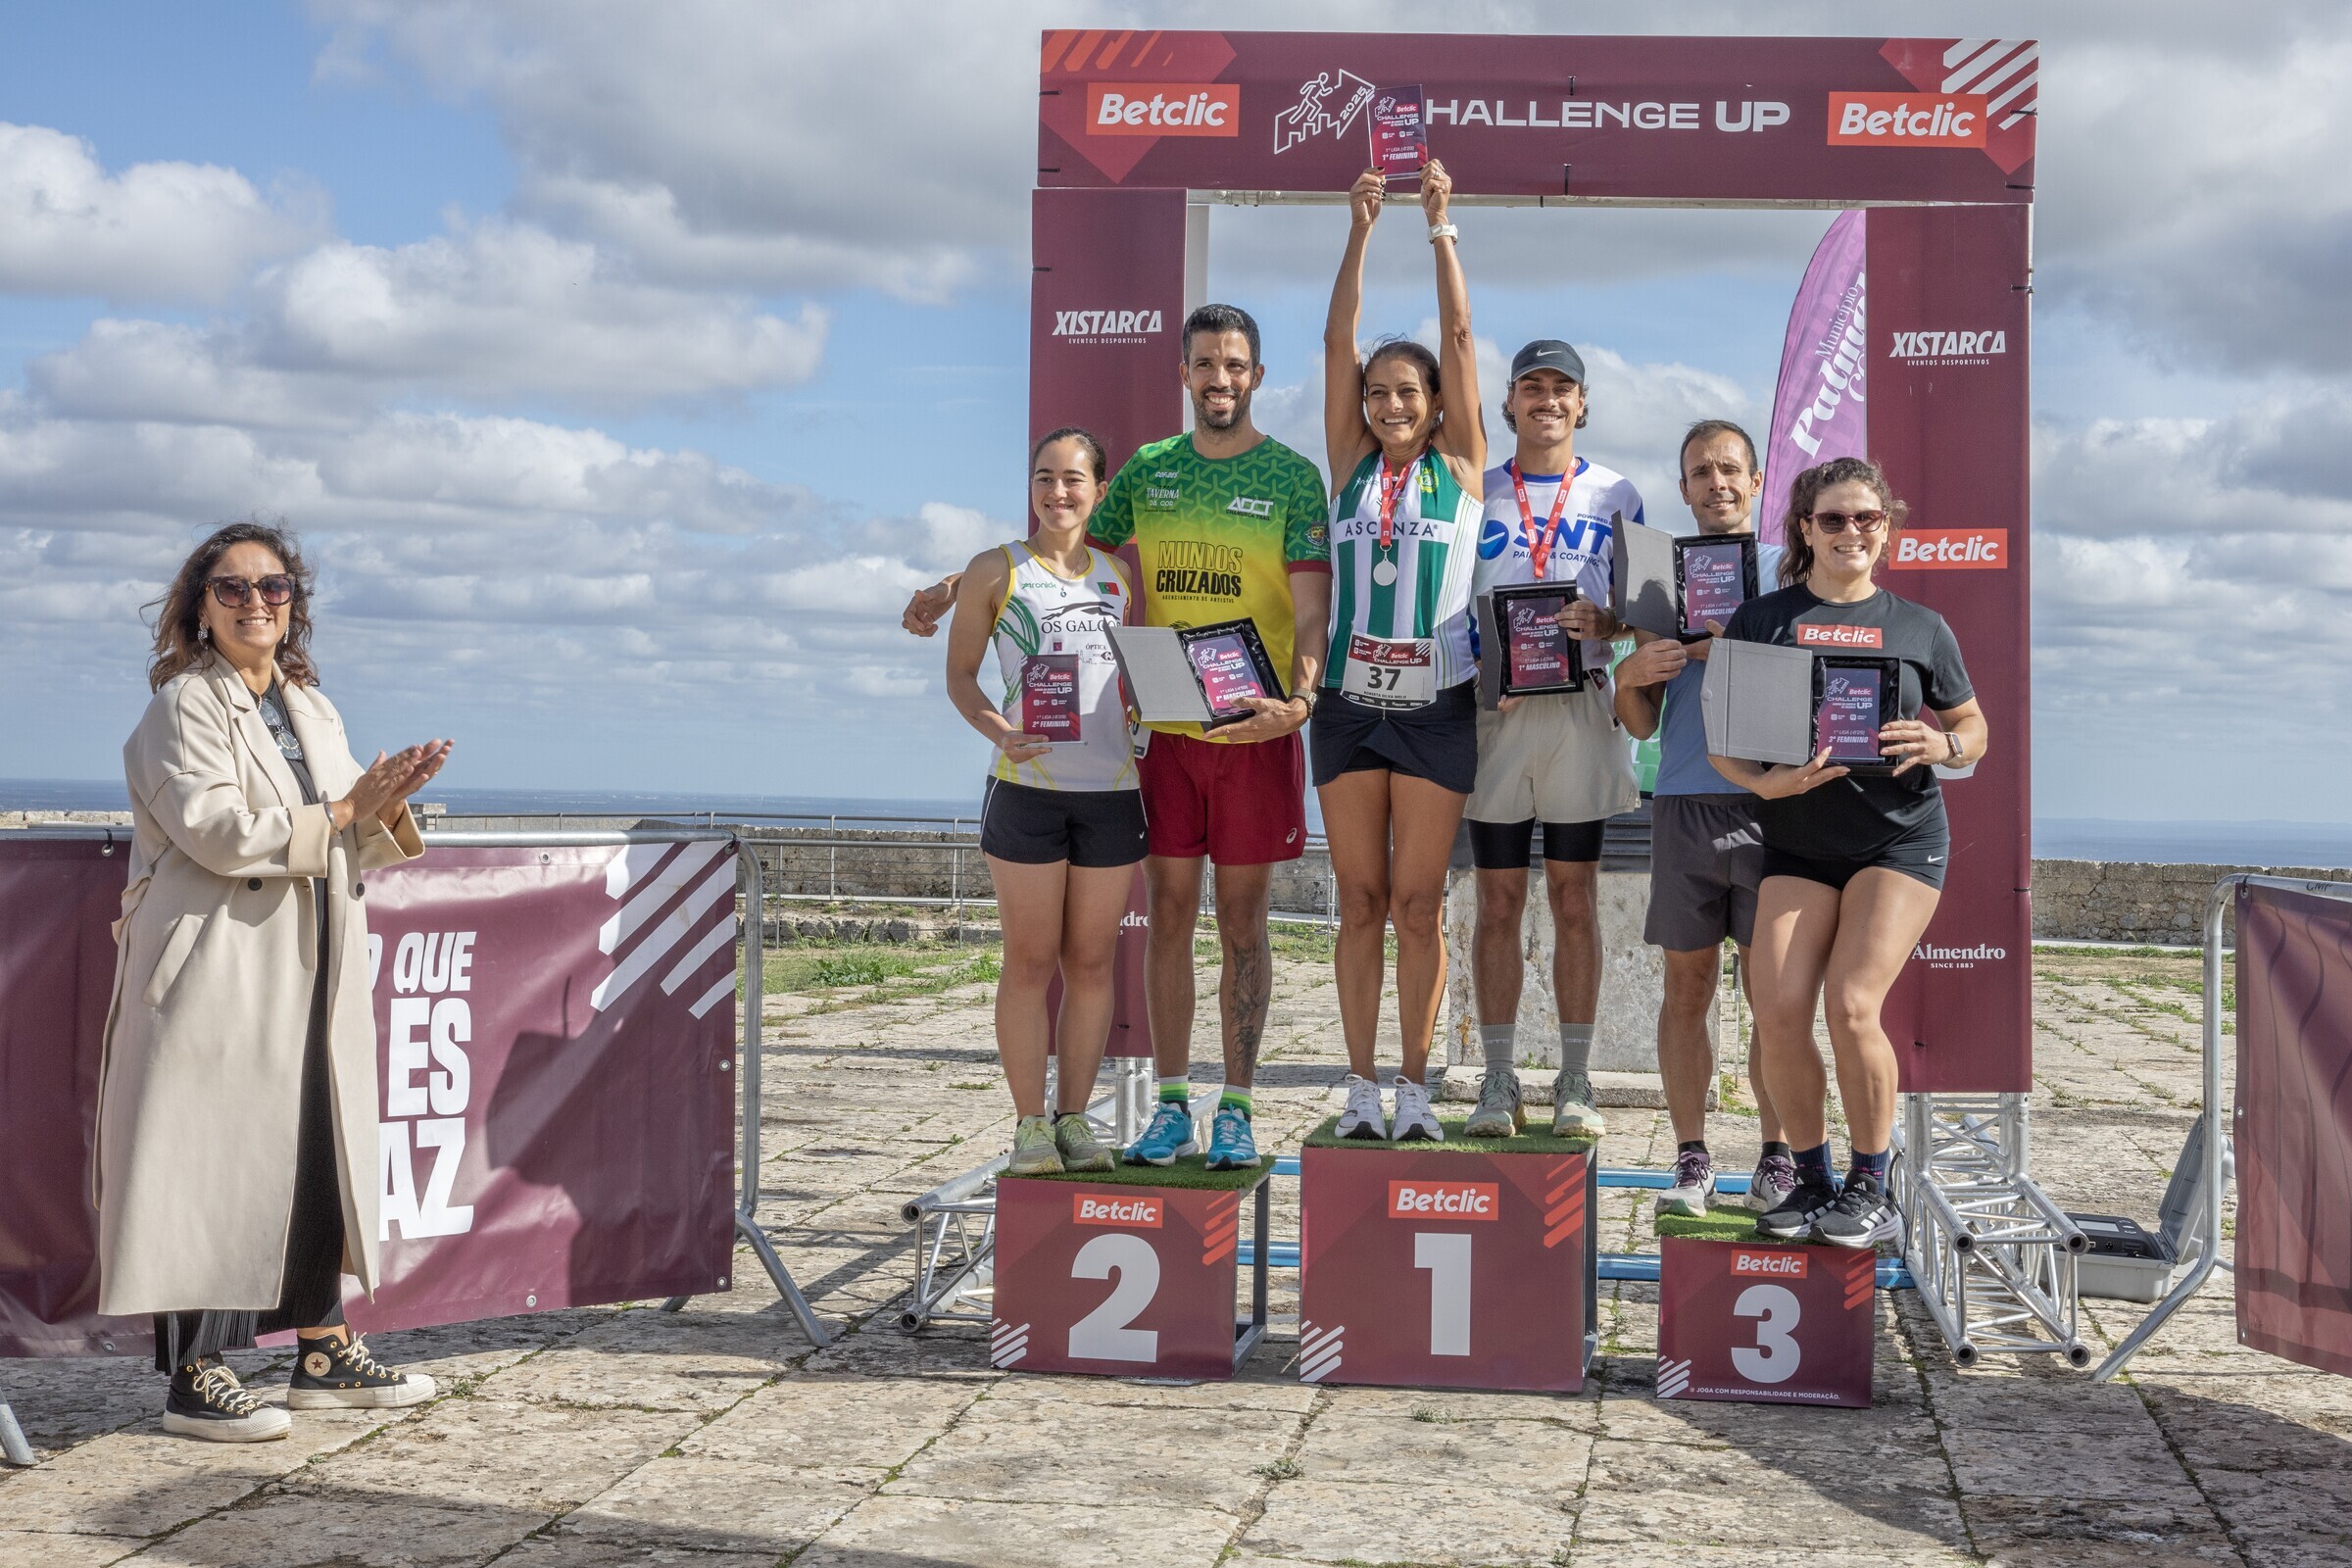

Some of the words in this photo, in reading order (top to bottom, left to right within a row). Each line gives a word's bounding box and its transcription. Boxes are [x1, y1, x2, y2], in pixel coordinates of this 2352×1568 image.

[1098, 92, 1228, 126] Betclic
[1340, 86, 1367, 121] 2025
[1426, 99, 1699, 129] HALLENGE
[1715, 101, 1790, 132] UP
[1838, 102, 1976, 138] Betclic
[1052, 311, 1162, 336] XISTARCA
[1815, 286, 1859, 361] Município
[1888, 330, 2006, 358] XISTARCA
[1789, 271, 1866, 459] Palme
[1147, 487, 1179, 499] TAVERNA
[1345, 521, 1439, 537] ASCNZA®
[1577, 513, 1608, 524] POWERED
[1513, 515, 1612, 556] SNT
[1157, 541, 1243, 574] MUNDOS
[1896, 536, 1999, 563] Betclic
[1156, 569, 1242, 597] CRUZADOS
[1042, 621, 1062, 634] OS
[1803, 628, 1876, 643] Betclic
[1202, 658, 1244, 668] CHALLENGE
[1526, 662, 1560, 670] MASCULINO
[1367, 666, 1401, 691] 37
[1223, 689, 1256, 701] MASCULINO
[393, 931, 477, 995] QUE
[1911, 943, 2006, 959] Almendro
[1079, 1200, 1156, 1222] Betclic
[1396, 1188, 1491, 1213] Betclic
[1736, 1254, 1802, 1274] Betclic
[1068, 1233, 1160, 1363] 2
[1414, 1232, 1471, 1356] 1
[1731, 1284, 1801, 1384] 3
[1731, 1389, 1791, 1397] RESPONSABILIDADE
[1798, 1392, 1840, 1400] MODERAÇÃO.
